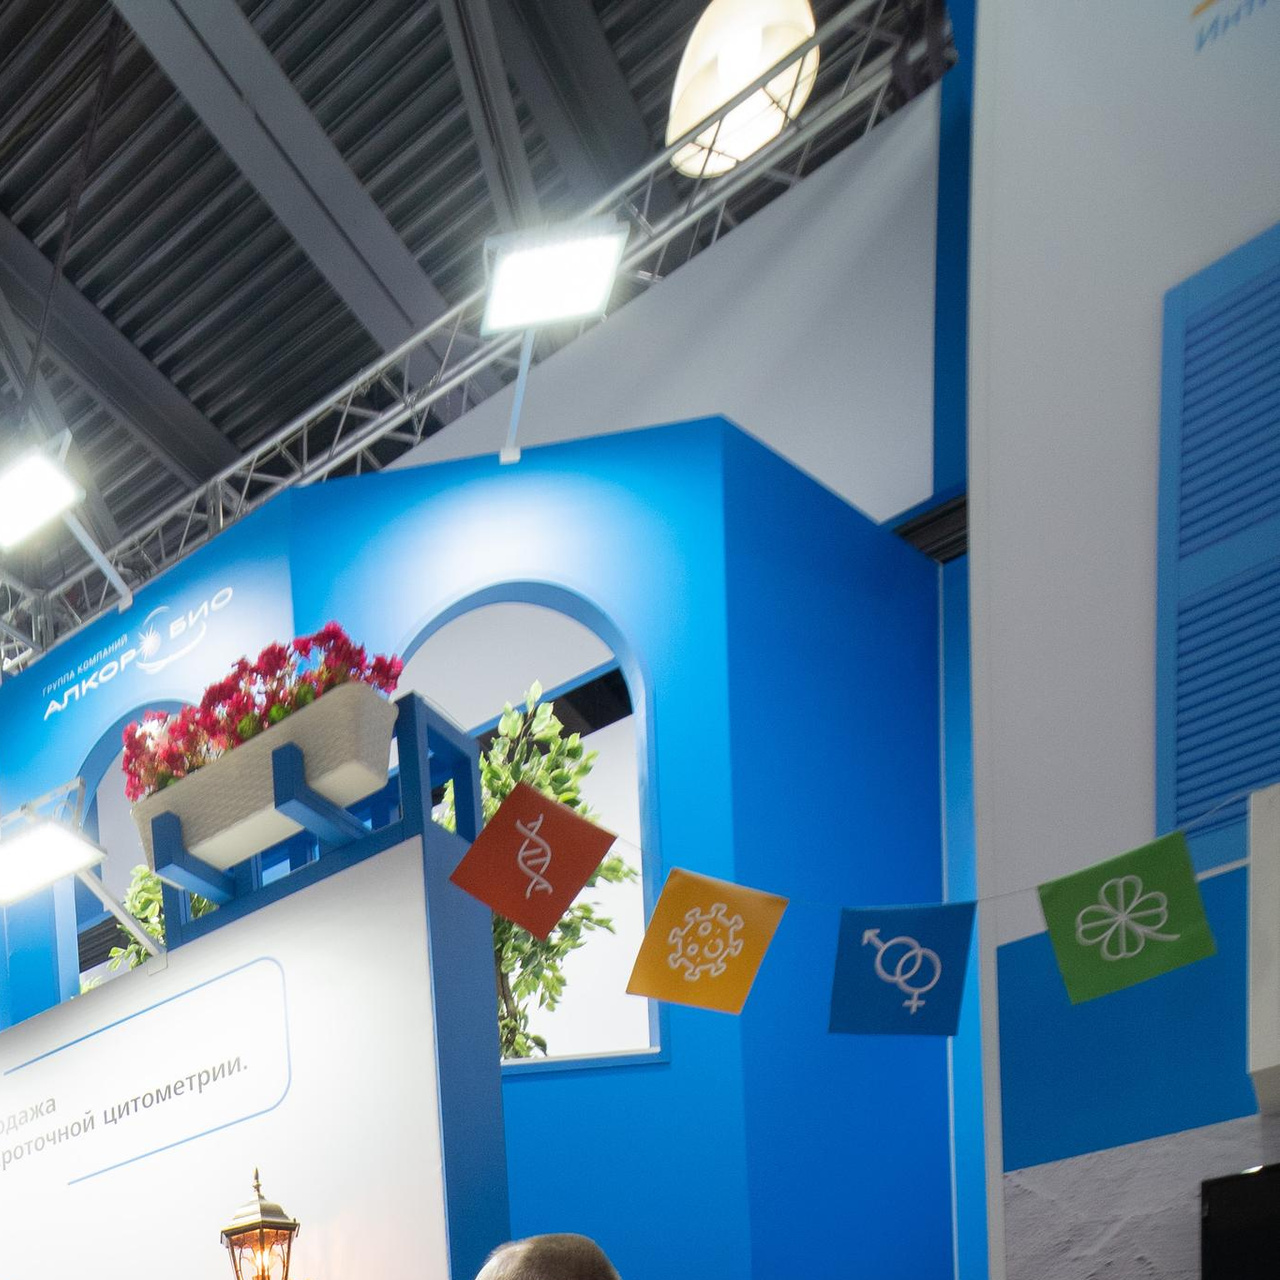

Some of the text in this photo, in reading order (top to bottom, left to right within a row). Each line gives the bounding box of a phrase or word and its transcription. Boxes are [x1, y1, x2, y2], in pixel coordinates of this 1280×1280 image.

[42, 633, 128, 698] ГРУППА КОМПАНИЙ
[43, 587, 234, 721] АЛКОР БИО
[103, 1056, 248, 1126] цитометрии.
